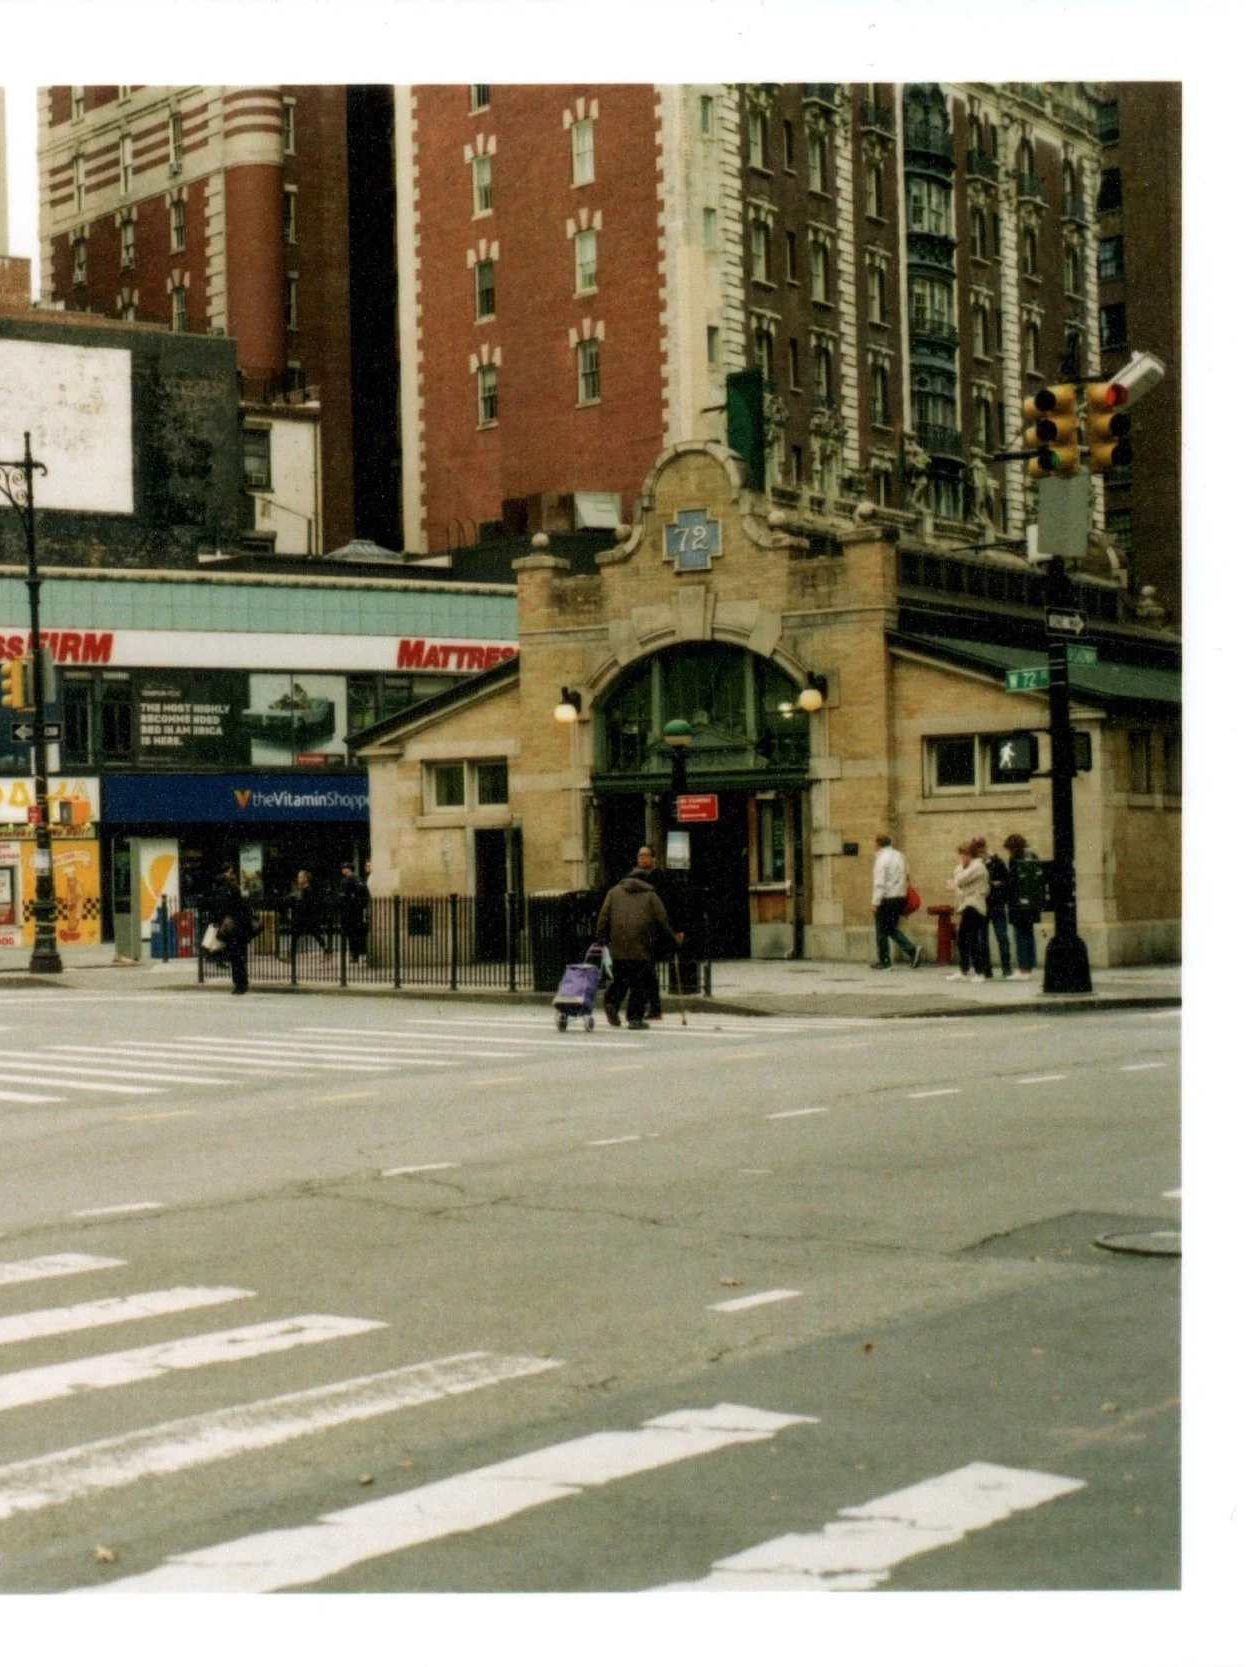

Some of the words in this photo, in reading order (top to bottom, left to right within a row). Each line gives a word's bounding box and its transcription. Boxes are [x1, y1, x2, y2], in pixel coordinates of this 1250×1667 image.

[673, 525, 710, 552] 72
[397, 639, 520, 669] MATTRES
[1022, 672, 1037, 688] 72
[141, 703, 161, 713] THE
[163, 704, 191, 713] MOST
[192, 704, 230, 714] HIGHLY
